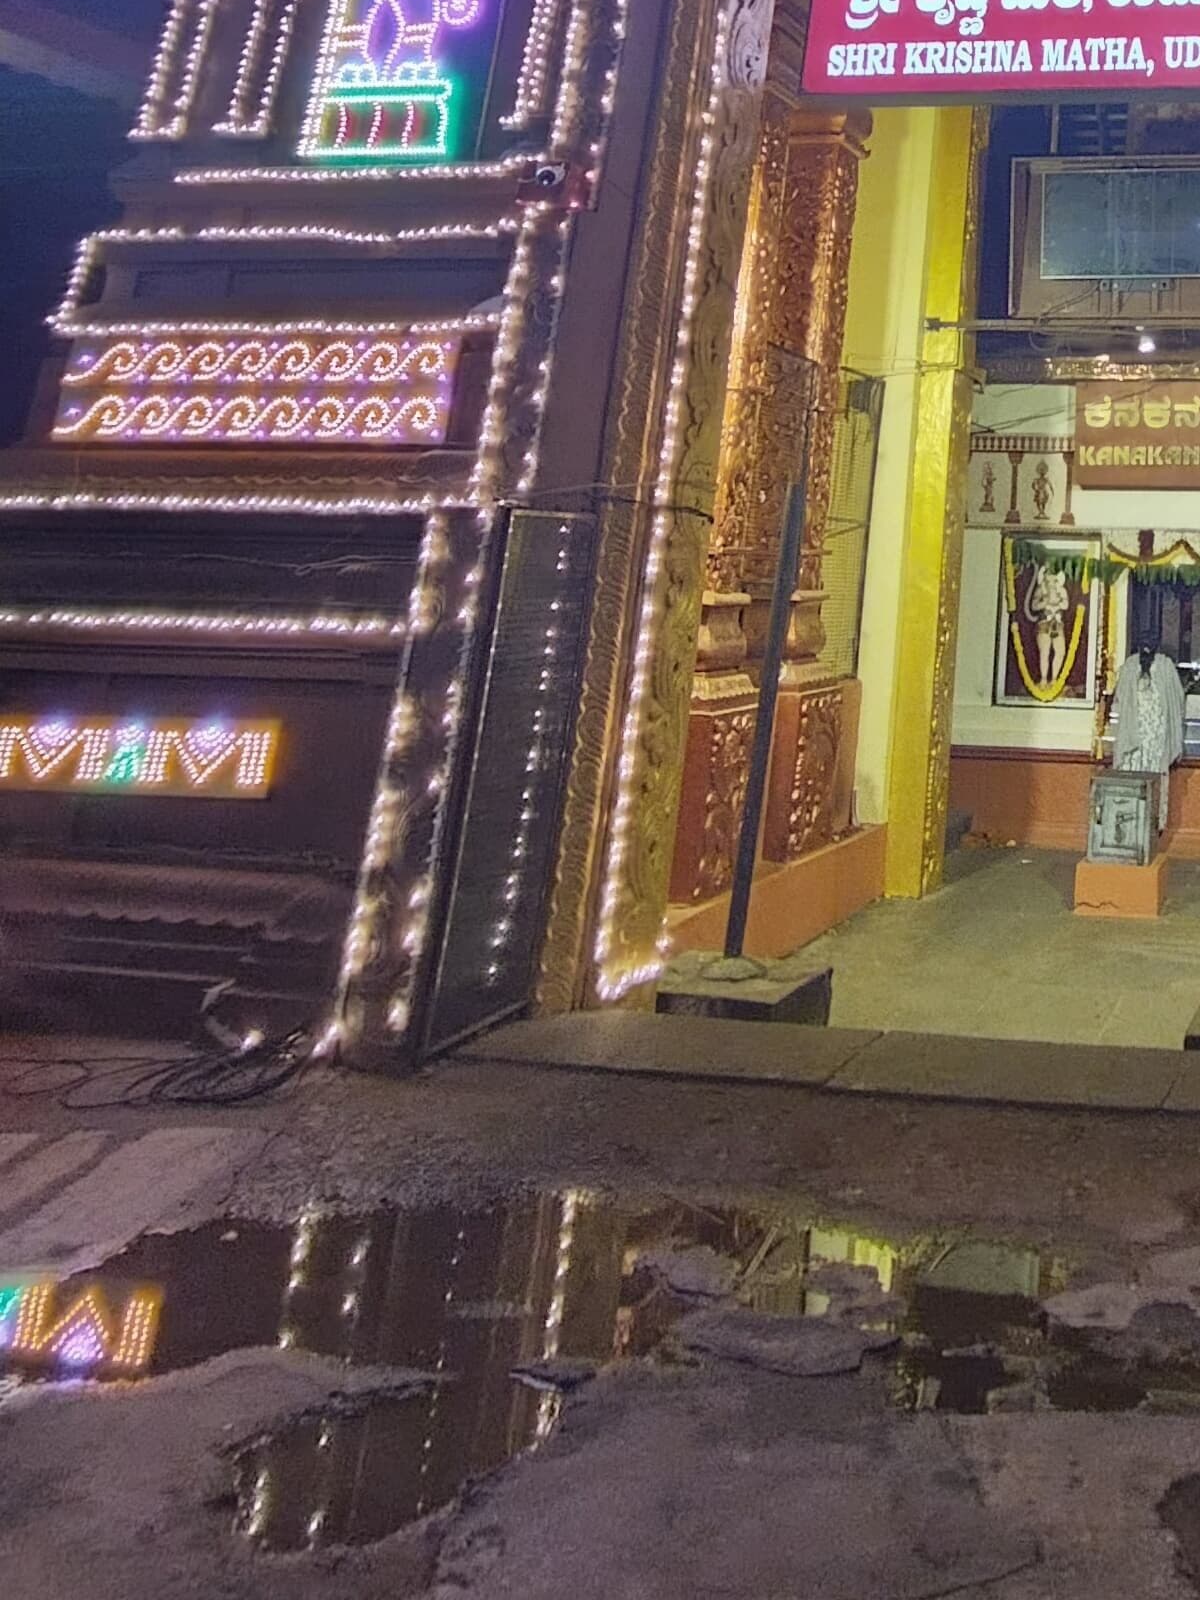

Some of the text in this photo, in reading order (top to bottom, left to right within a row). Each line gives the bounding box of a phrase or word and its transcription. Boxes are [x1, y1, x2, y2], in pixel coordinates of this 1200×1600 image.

[827, 43, 898, 76] SHRI
[902, 40, 1033, 74] KRISHNA
[1040, 37, 1154, 77] MATHA,
